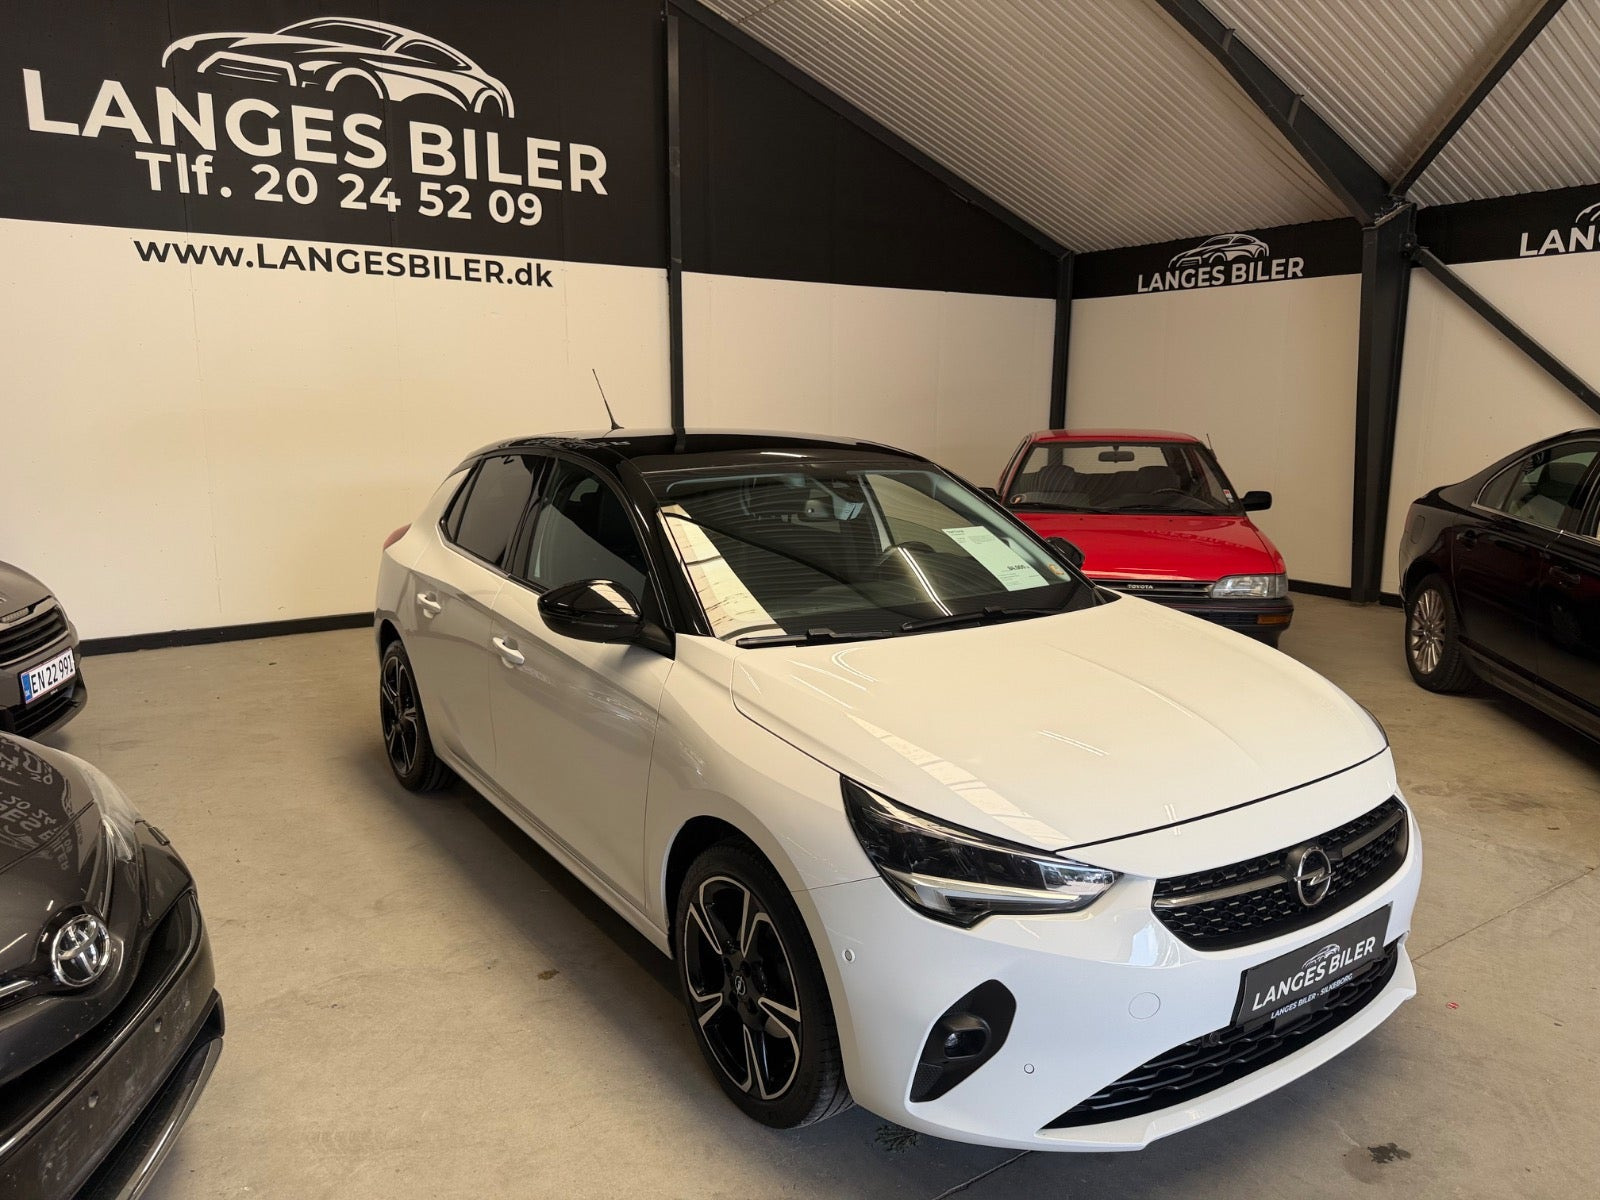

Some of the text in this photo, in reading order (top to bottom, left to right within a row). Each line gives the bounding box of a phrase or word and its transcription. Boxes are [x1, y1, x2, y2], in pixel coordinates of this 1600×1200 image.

[22, 68, 608, 196] LANGES BILER
[135, 151, 543, 226] Tlf. 20 24 52 09
[133, 240, 554, 288] www.LANGESBILER.dk
[1519, 224, 1600, 257] LAN
[1137, 257, 1305, 293] LANGES BILER
[31, 655, 73, 694] EN 22 991
[1252, 936, 1376, 1011] LANGES BILER
[1271, 1001, 1298, 1019] LANGES
[1298, 992, 1317, 1007] BILER
[1320, 973, 1353, 996] SILKEBORG
